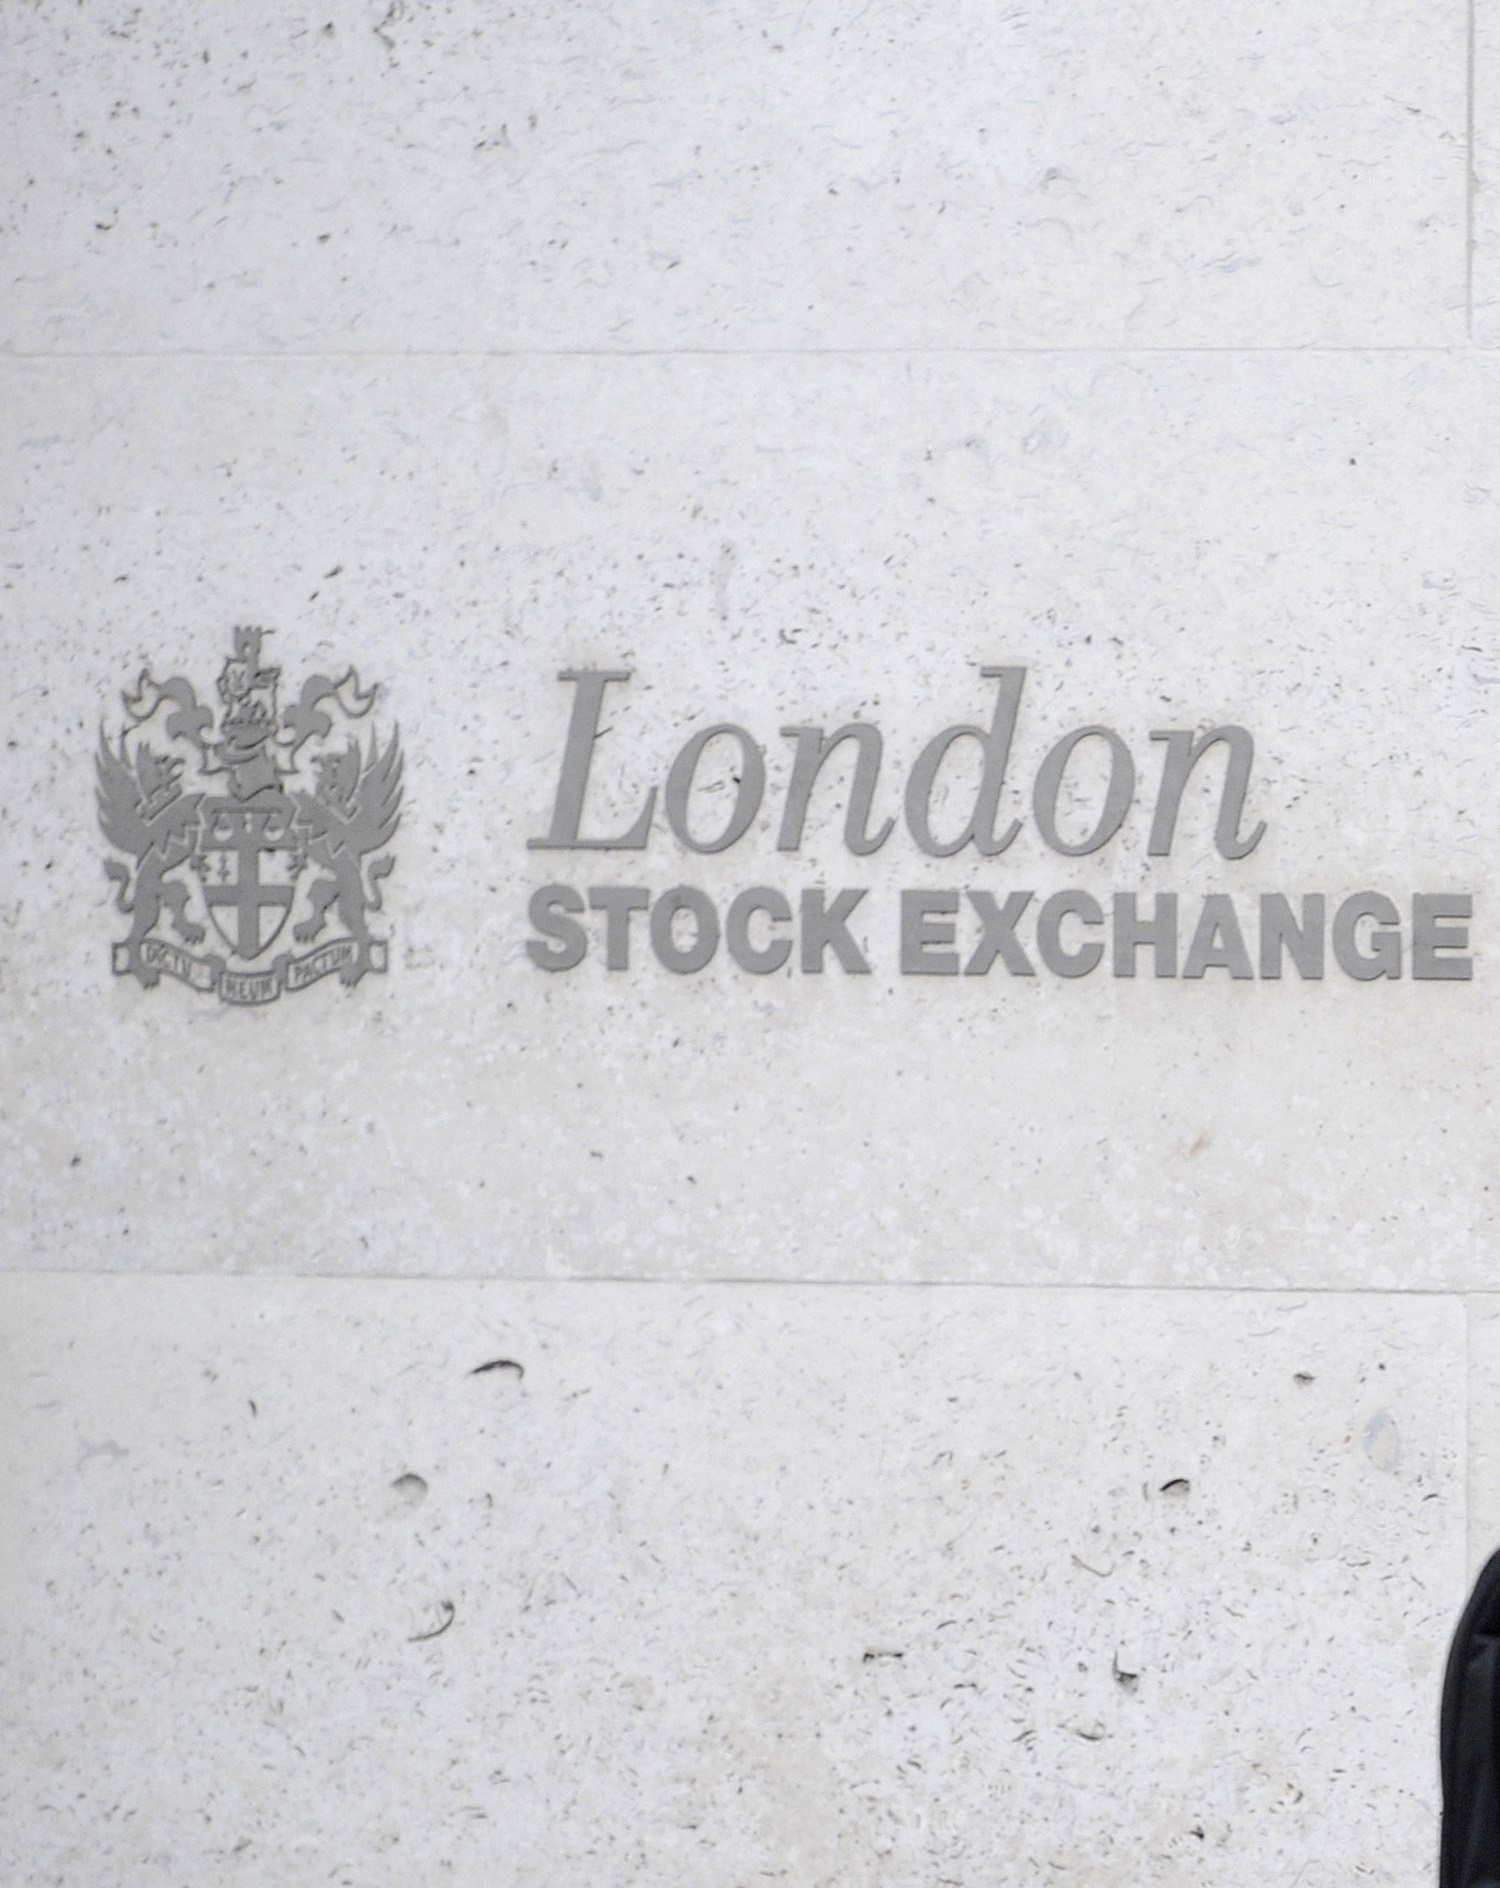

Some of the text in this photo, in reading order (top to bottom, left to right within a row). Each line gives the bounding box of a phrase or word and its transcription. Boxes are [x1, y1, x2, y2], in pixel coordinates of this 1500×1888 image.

[526, 665, 1267, 861] London
[525, 882, 1474, 983] STOCK EXCHANGE
